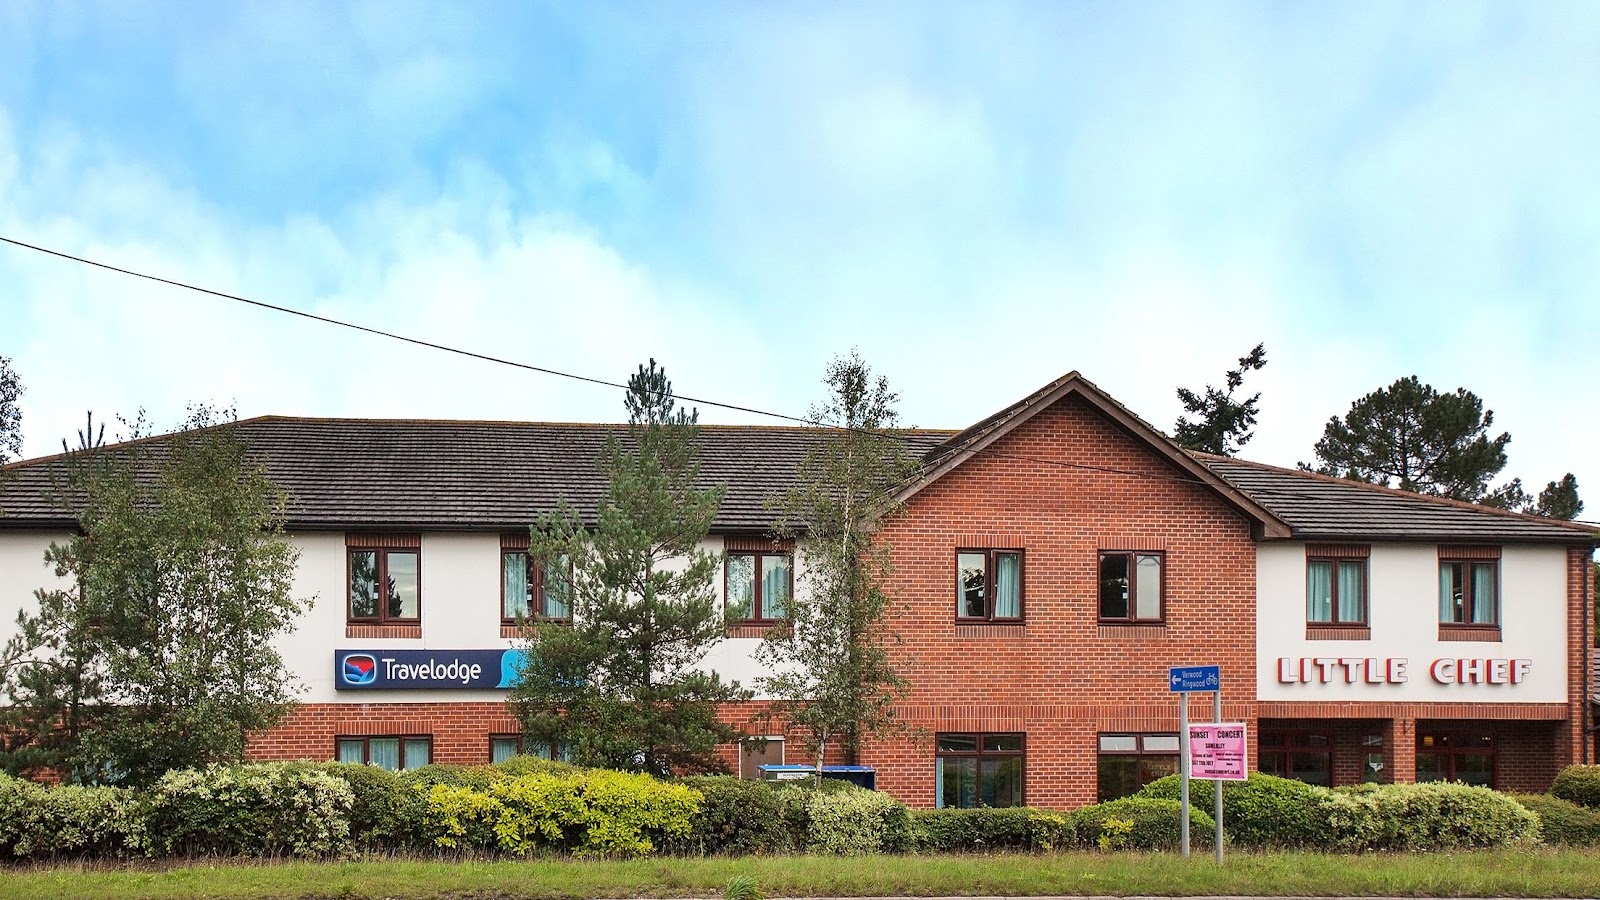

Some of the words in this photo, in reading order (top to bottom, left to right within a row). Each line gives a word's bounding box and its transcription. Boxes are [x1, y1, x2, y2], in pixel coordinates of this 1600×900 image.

[381, 658, 482, 685] Travelodge
[1182, 670, 1203, 678] Verwood
[1277, 657, 1409, 684] LITTLE
[1429, 657, 1533, 685] CHEF
[1182, 679, 1205, 689] Ringwood
[1190, 731, 1209, 739] SUNSET
[1217, 730, 1244, 739] CONCERT
